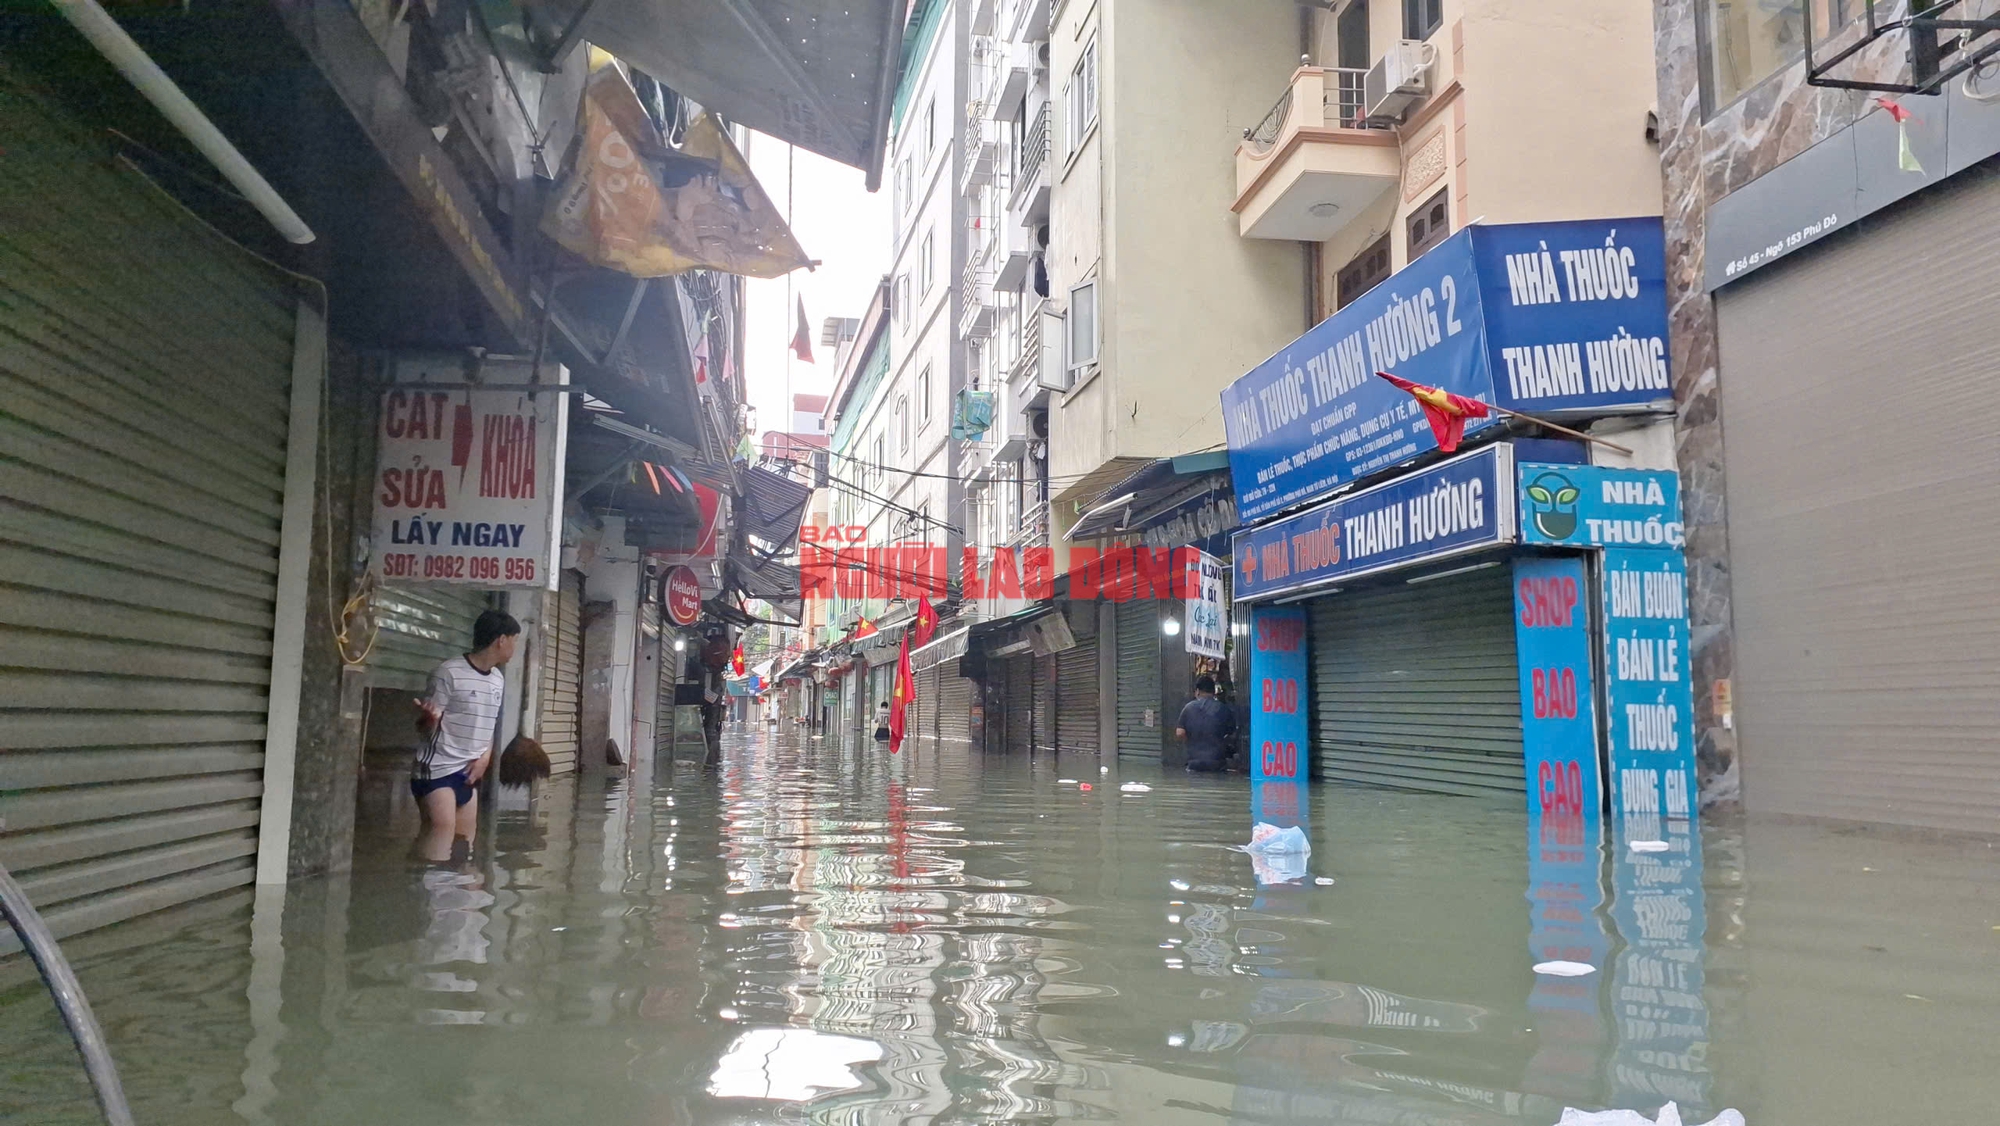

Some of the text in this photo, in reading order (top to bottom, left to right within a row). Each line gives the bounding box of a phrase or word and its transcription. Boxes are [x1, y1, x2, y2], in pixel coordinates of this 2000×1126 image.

[1749, 252, 1759, 265] 45
[1765, 240, 1784, 257] Ngõ
[1785, 231, 1802, 247] 153
[1803, 221, 1822, 240] Phú
[1823, 213, 1838, 229] Đô
[1505, 229, 1639, 306] NHÀ THUỐC
[1233, 274, 1463, 449] NHÀ THUỐC THANH HƯỜNG 2
[1502, 326, 1669, 400] THANH HƯỜNG
[1344, 401, 1358, 421] GPP
[1389, 410, 1396, 423] Y
[381, 454, 447, 509] SỬA
[1602, 477, 1665, 505] NHÀ
[391, 512, 526, 548] LẤY NGAY
[1262, 531, 1290, 582] NHÀ
[1292, 504, 1341, 574] THUỐC
[1344, 502, 1404, 560] THANH
[1409, 477, 1484, 544] HƯỜNG
[1585, 514, 1685, 546] THUỐC
[470, 556, 500, 580] 096
[505, 557, 535, 581] 956
[672, 579, 698, 598] HelloVi
[1611, 560, 1684, 619] BÁN BUÔN
[682, 596, 698, 610] Mart
[1519, 576, 1578, 627] SHOP
[1257, 617, 1303, 652] SHOP
[1617, 625, 1680, 682] BÁN LẺ
[1262, 678, 1297, 714] BAO
[1532, 667, 1577, 719] BAO
[1625, 688, 1679, 751] THUỐC
[1262, 740, 1297, 777] CAO
[1538, 760, 1584, 813] CAO
[1664, 760, 1690, 813] GIÁ
